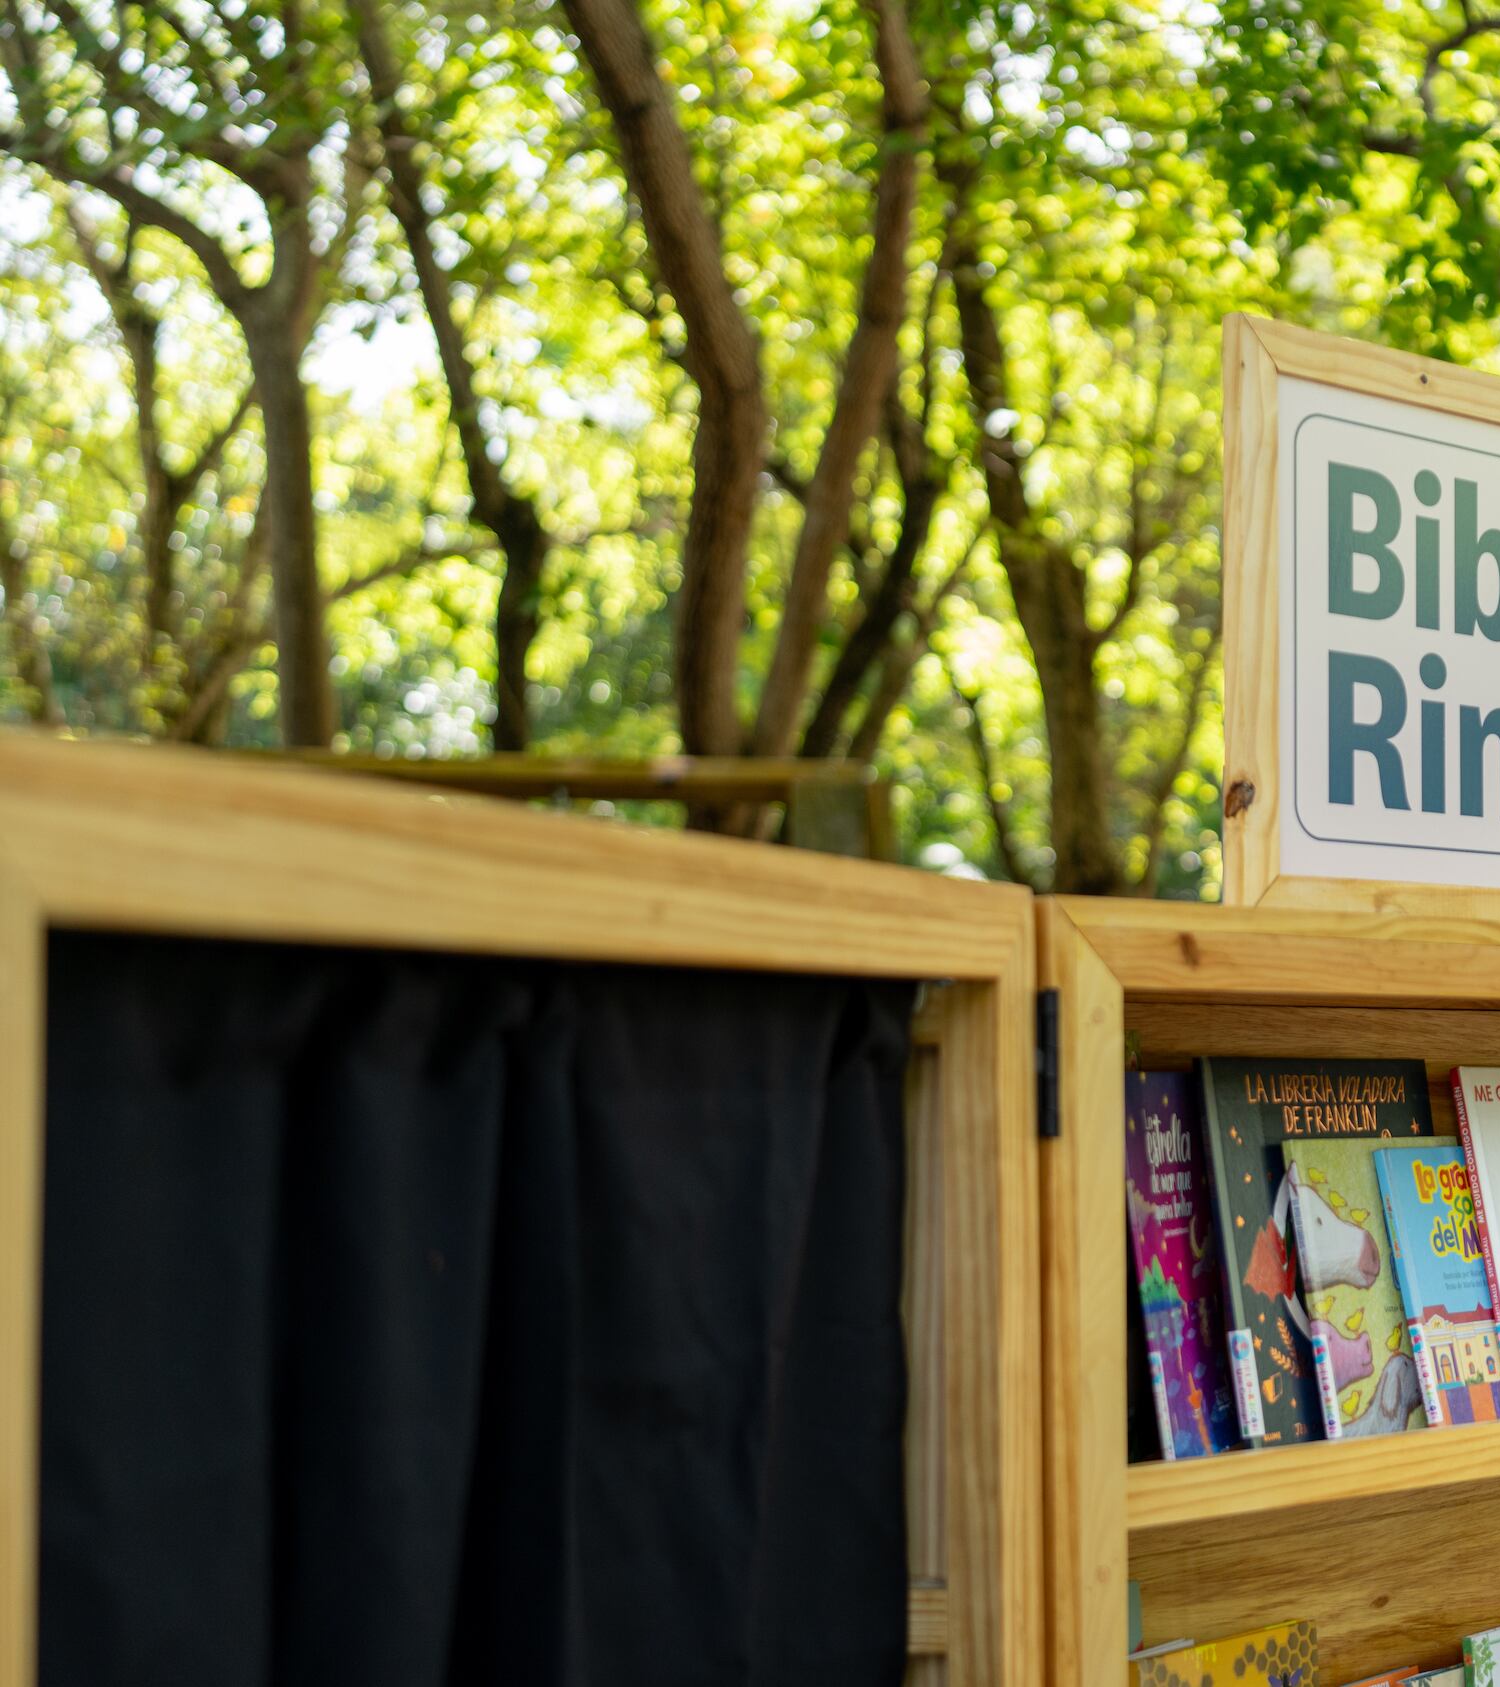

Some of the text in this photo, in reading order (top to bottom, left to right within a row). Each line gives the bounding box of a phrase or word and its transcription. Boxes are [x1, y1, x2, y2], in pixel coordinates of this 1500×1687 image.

[1245, 1073, 1268, 1104] LA
[1339, 1075, 1406, 1104] VOLADORA
[1474, 1085, 1494, 1102] ME
[1283, 1104, 1377, 1134] DE FRANKLIN
[1461, 1127, 1476, 1172] CONTIGO
[1414, 1164, 1436, 1200] La
[1470, 1174, 1482, 1207] QUEDO
[1475, 1211, 1485, 1224] ME
[1433, 1216, 1461, 1252] del
